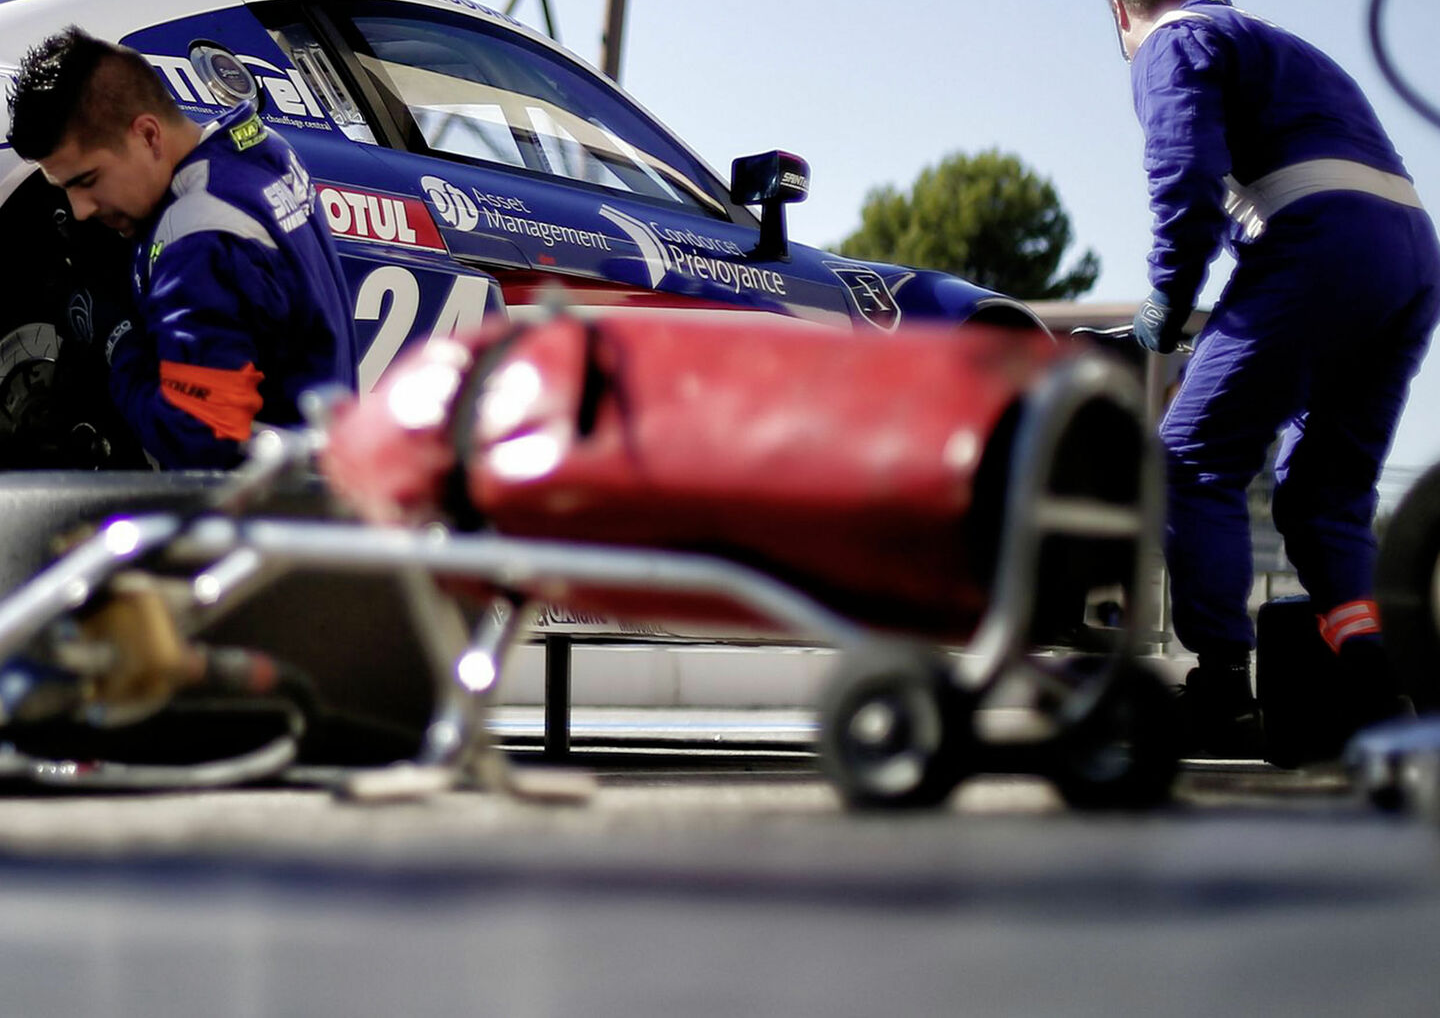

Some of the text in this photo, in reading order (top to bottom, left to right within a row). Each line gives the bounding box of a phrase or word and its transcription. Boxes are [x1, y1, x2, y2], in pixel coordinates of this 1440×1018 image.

[304, 119, 332, 131] central
[472, 187, 531, 214] Asset
[483, 207, 612, 251] Management
[650, 221, 747, 258] Condorcet
[668, 244, 787, 295] Prévoyance
